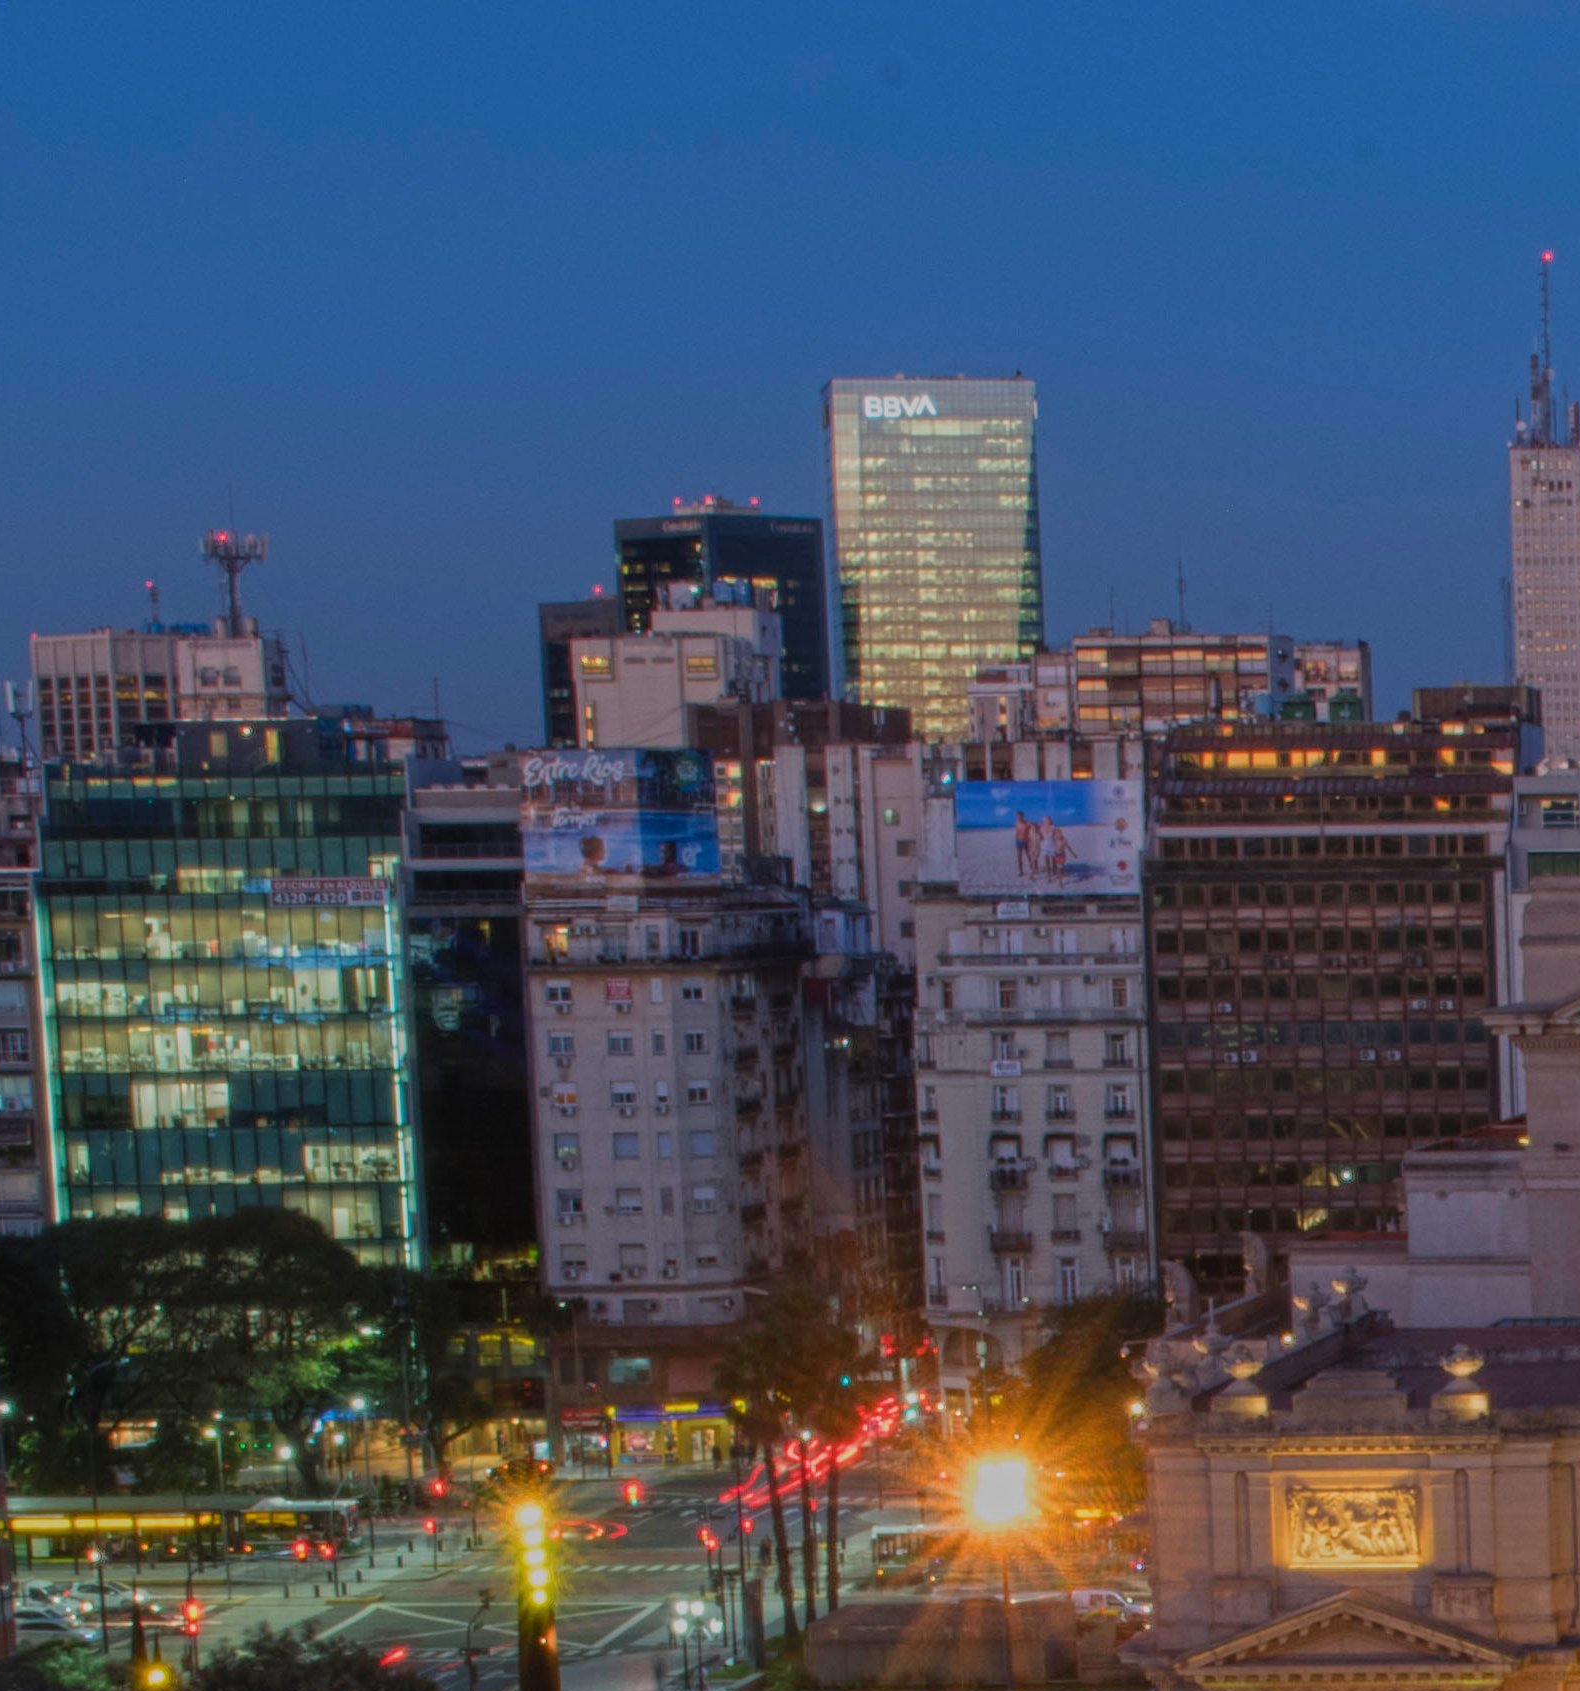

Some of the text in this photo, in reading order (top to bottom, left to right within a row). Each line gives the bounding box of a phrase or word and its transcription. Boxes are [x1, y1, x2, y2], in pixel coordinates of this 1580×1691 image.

[864, 395, 937, 418] BBVA
[523, 756, 580, 786] Entre
[274, 880, 321, 891] OFICINAS
[336, 879, 385, 890] ALQUILER
[274, 892, 346, 904] 4320-4320
